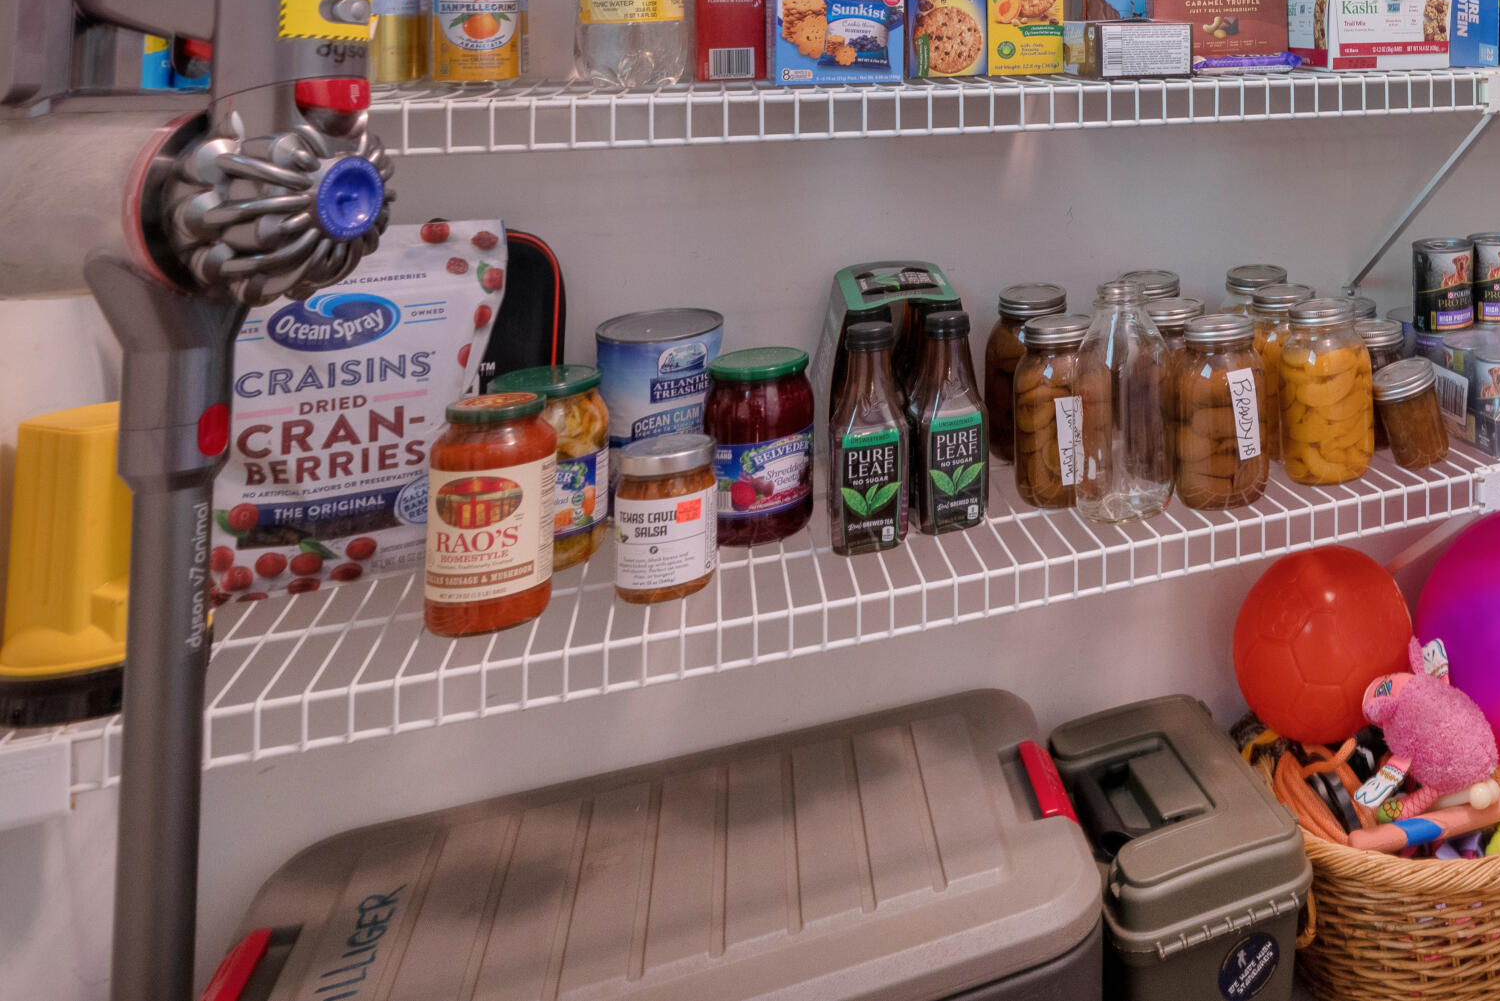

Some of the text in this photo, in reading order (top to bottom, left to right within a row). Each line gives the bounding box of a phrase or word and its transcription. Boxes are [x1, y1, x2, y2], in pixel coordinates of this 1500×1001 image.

[831, 3, 886, 20] Sunkist
[1185, 0, 1224, 7] CARAMEL
[1342, 0, 1378, 15] Kashi
[360, 272, 428, 285] CRANBERRIES
[410, 308, 445, 317] OWNED
[1485, 305, 1498, 315] HIGH
[275, 311, 385, 343] Ocean Spray
[235, 351, 433, 398] CRAISINS
[653, 373, 709, 391] ATLANTIC
[654, 380, 710, 399] TREASURE
[298, 395, 368, 416] DRIED
[635, 406, 700, 433] OCEAN CLAM
[236, 405, 425, 460] CRAN-
[936, 428, 978, 447] PURE
[847, 445, 894, 465] PURE
[936, 443, 978, 462] LEAF
[951, 456, 973, 466] SUGAR
[245, 440, 426, 487] BERRIES
[847, 459, 894, 479] LEAF
[852, 475, 889, 486] NO SUGAR
[274, 495, 385, 520] THE ORIGINAL
[620, 510, 678, 524] TEXAS CAVI
[192, 501, 209, 566] animal
[634, 525, 668, 539] SALSA
